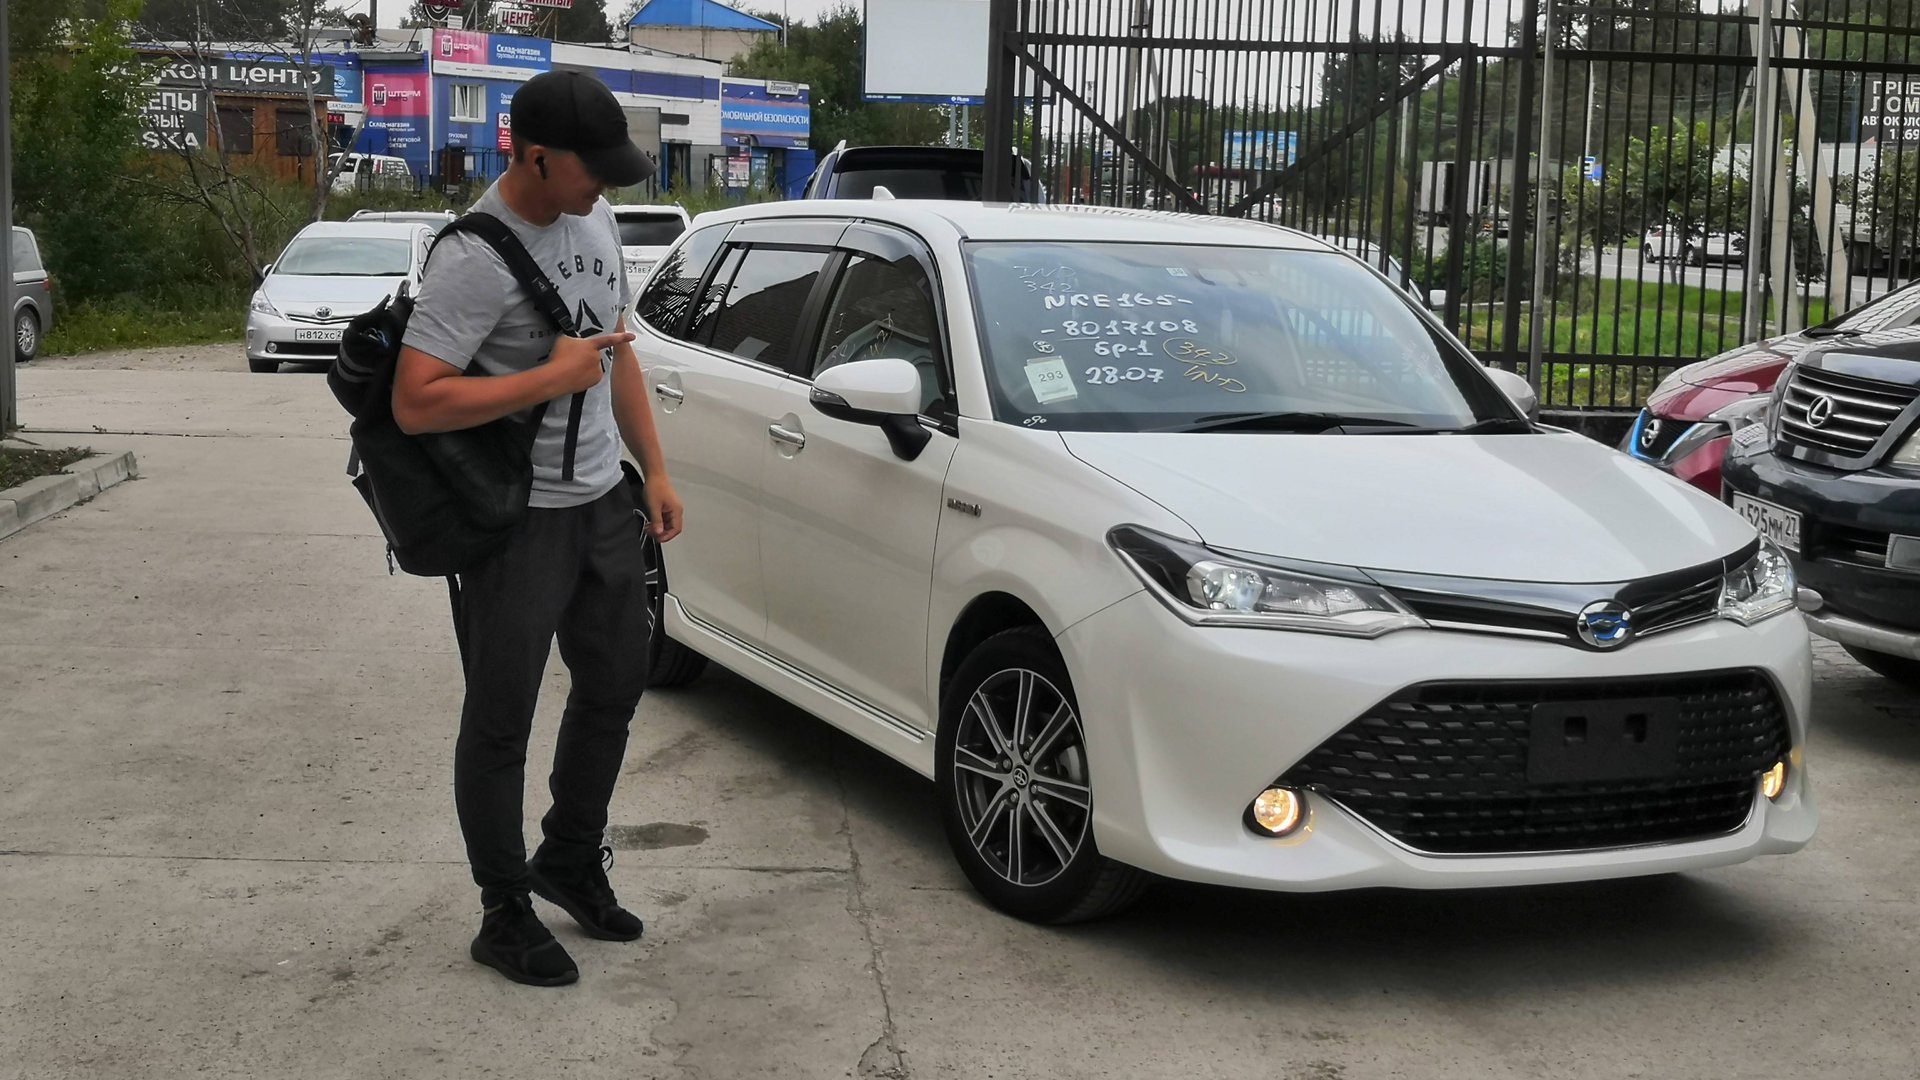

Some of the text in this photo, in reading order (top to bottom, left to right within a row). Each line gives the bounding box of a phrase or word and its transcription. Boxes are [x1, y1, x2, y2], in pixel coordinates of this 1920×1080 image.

[501, 10, 535, 25] ЦЕНТР
[1889, 128, 1920, 140] 169
[1023, 280, 1076, 295] 342
[1038, 370, 1064, 382] 293
[1085, 366, 1165, 385] 28.07
[1785, 515, 1797, 538] 27
